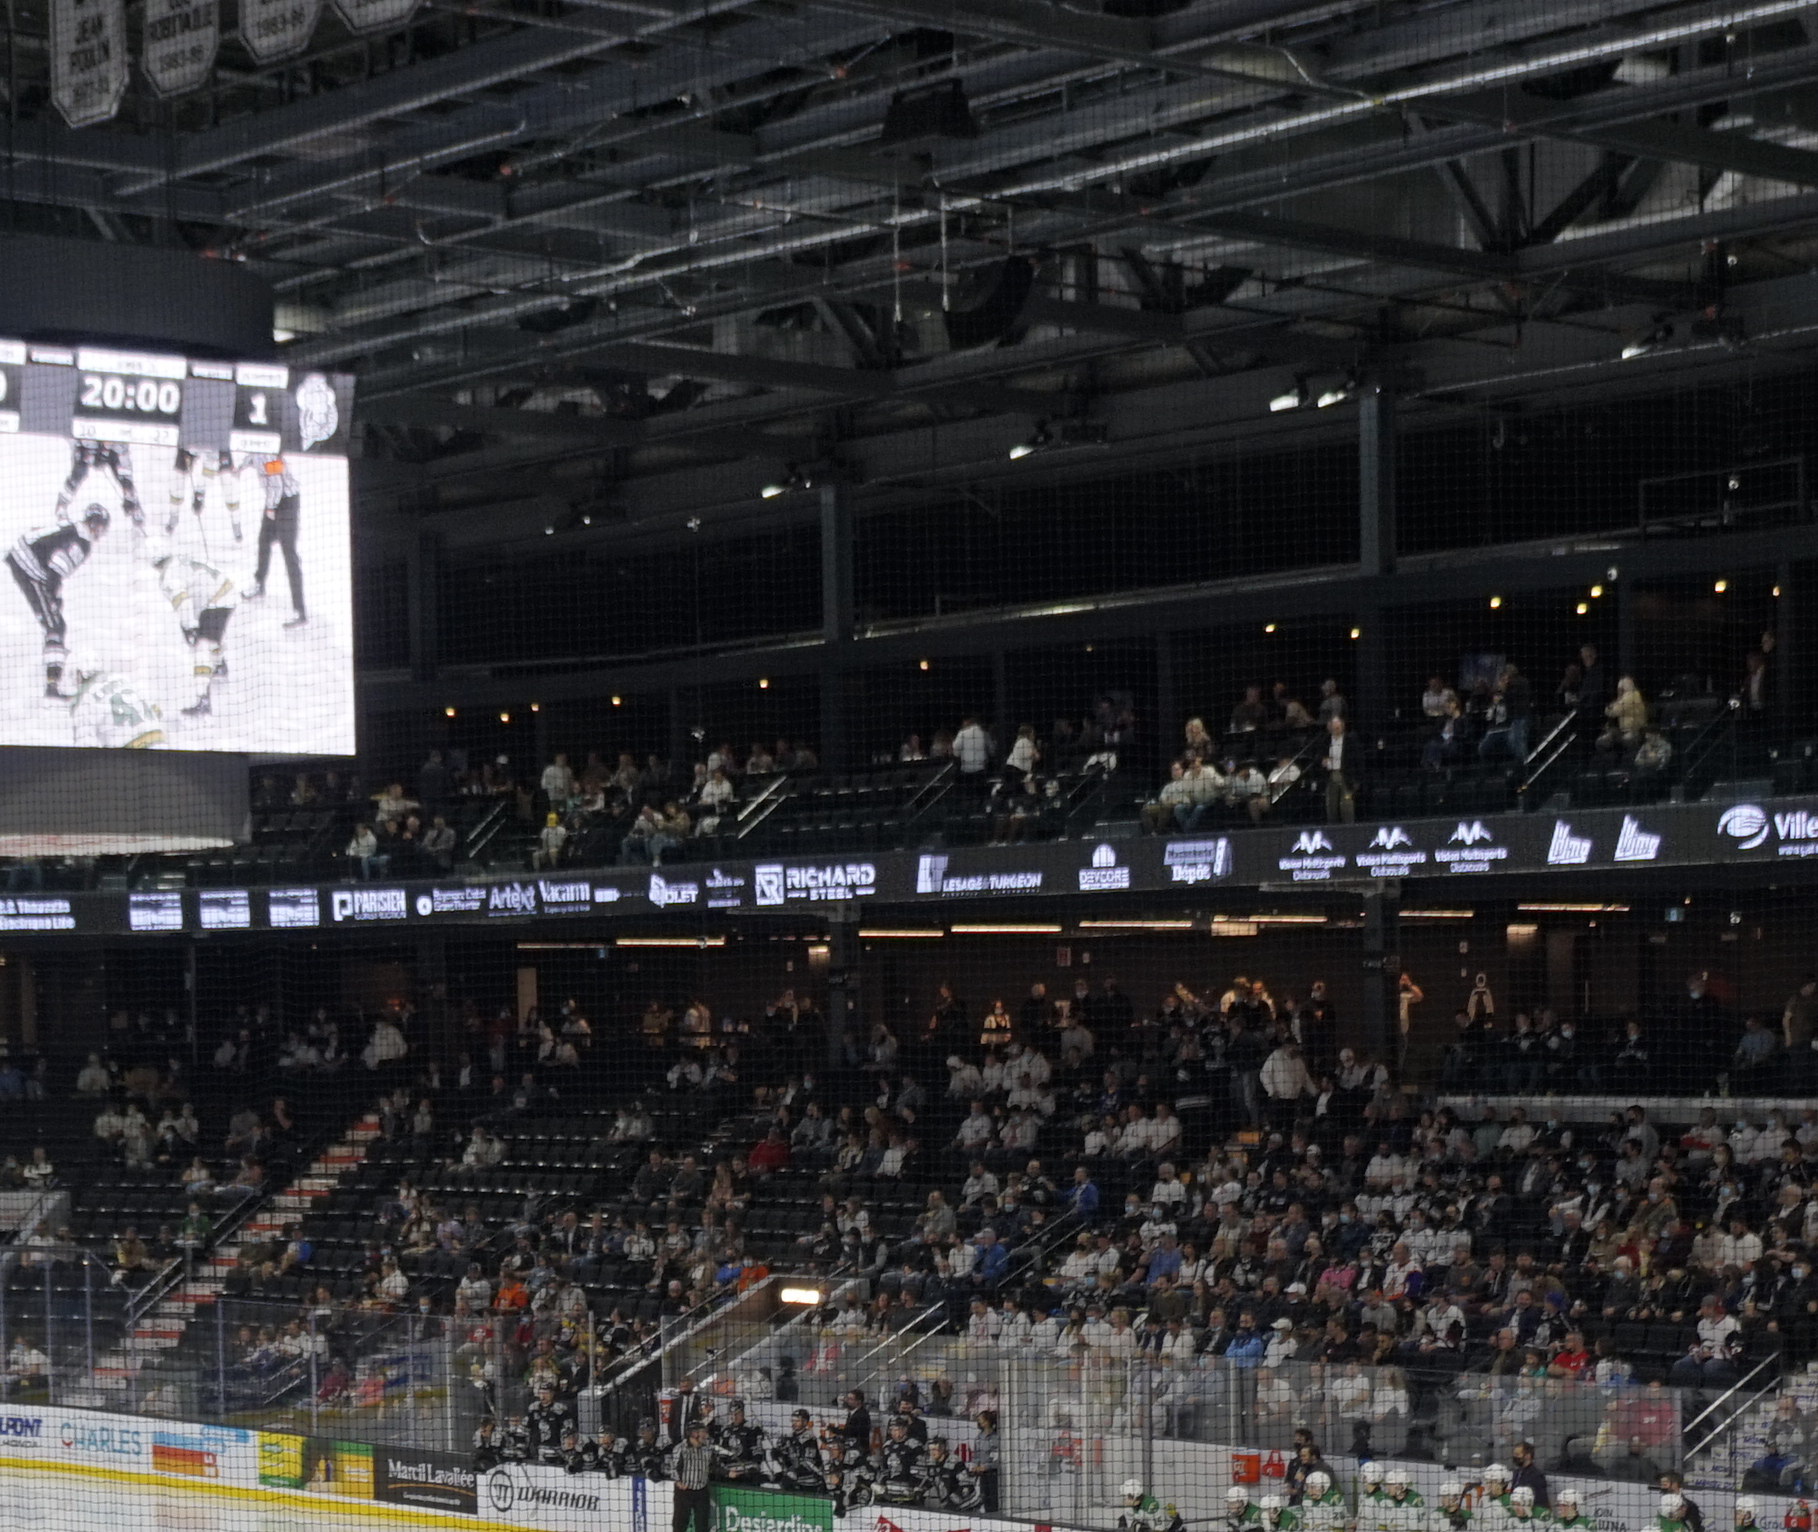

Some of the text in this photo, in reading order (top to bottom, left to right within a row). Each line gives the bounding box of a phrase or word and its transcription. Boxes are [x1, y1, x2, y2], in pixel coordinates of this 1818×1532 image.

[81, 376, 181, 414] 20:00
[249, 394, 267, 426] 1
[786, 863, 876, 889] RICHARD
[354, 889, 407, 912] PARISIEN
[810, 887, 853, 901] STEEL
[60, 1423, 141, 1456] CHARLES
[517, 1485, 600, 1512] WARRIOR
